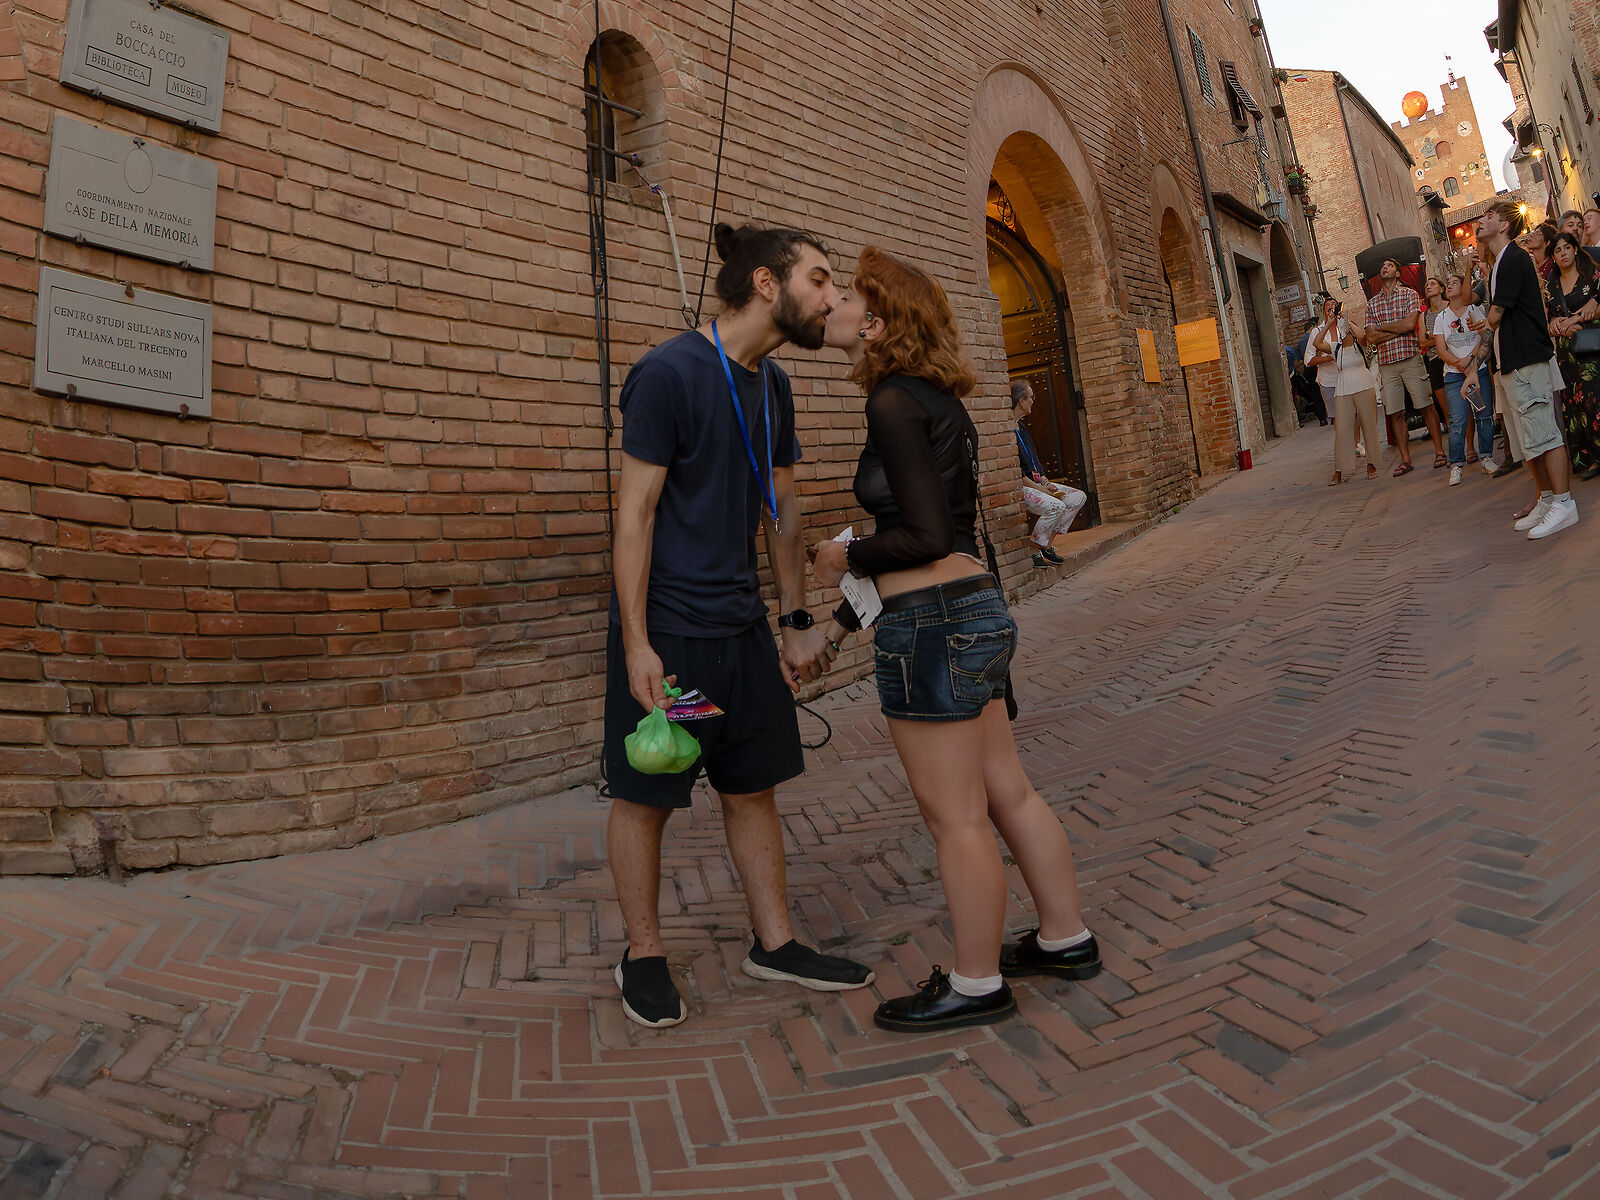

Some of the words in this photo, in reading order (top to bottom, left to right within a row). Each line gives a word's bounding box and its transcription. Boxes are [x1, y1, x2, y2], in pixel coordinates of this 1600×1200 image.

[130, 19, 154, 37] CASA
[160, 31, 176, 45] DEL
[115, 33, 186, 68] BOCCACCIO
[92, 54, 146, 80] BIBLIOTECA
[171, 82, 202, 99] MUSEO
[77, 189, 144, 213] COORDINAMENTO
[148, 208, 192, 226] NAZIONALE
[65, 202, 96, 220] CASE
[101, 211, 138, 231] DELLA
[143, 222, 199, 247] MEMORIA
[54, 306, 94, 322] CENTRO
[96, 316, 125, 329] STUDI
[127, 322, 172, 339] SULL'ARS
[174, 331, 200, 344] NOVA
[66, 327, 114, 345] ITALIANA
[117, 338, 136, 349] DEL
[138, 341, 187, 359] TRECENTO
[82, 356, 136, 374] MARCELLO
[138, 367, 172, 380] MASINI
